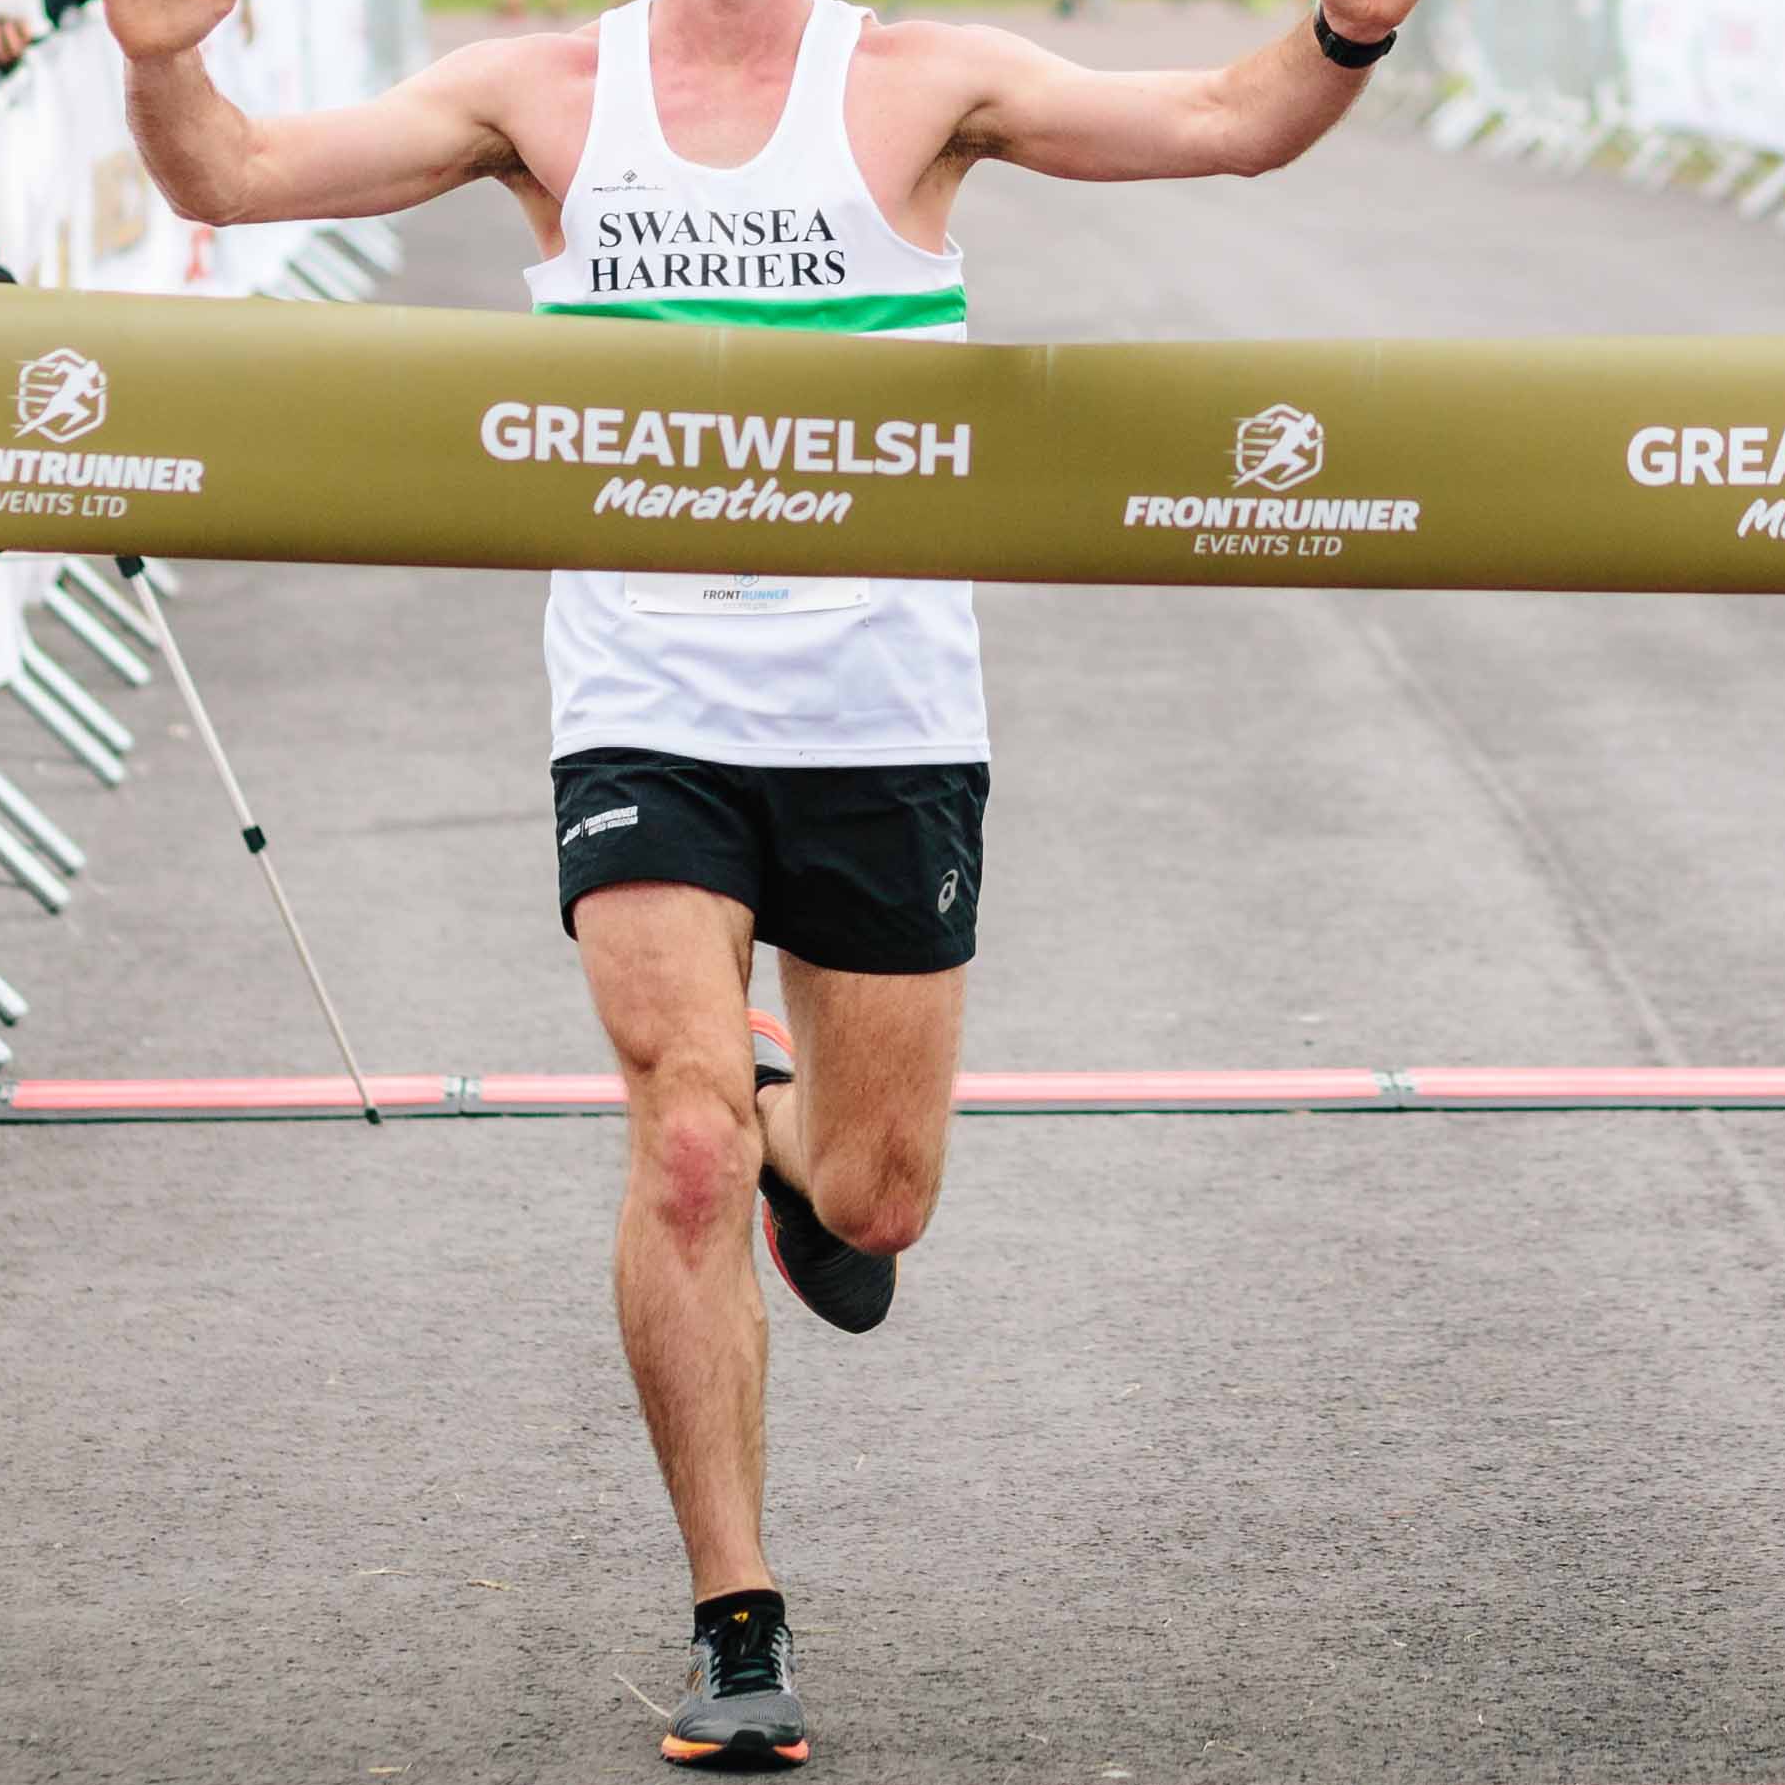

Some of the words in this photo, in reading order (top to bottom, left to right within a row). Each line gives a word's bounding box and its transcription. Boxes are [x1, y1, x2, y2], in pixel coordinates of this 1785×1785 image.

[598, 207, 836, 248] SWANSEA
[589, 250, 846, 293] HARRIERS
[480, 401, 971, 477] GREATWELSH
[81, 494, 127, 518] LTD
[593, 476, 853, 524] Marathon
[1123, 495, 1420, 531] FRONTRUNNER
[1193, 534, 1290, 556] EVENTS
[1297, 535, 1343, 557] LTD
[702, 589, 790, 601] FRONTRUNNER
